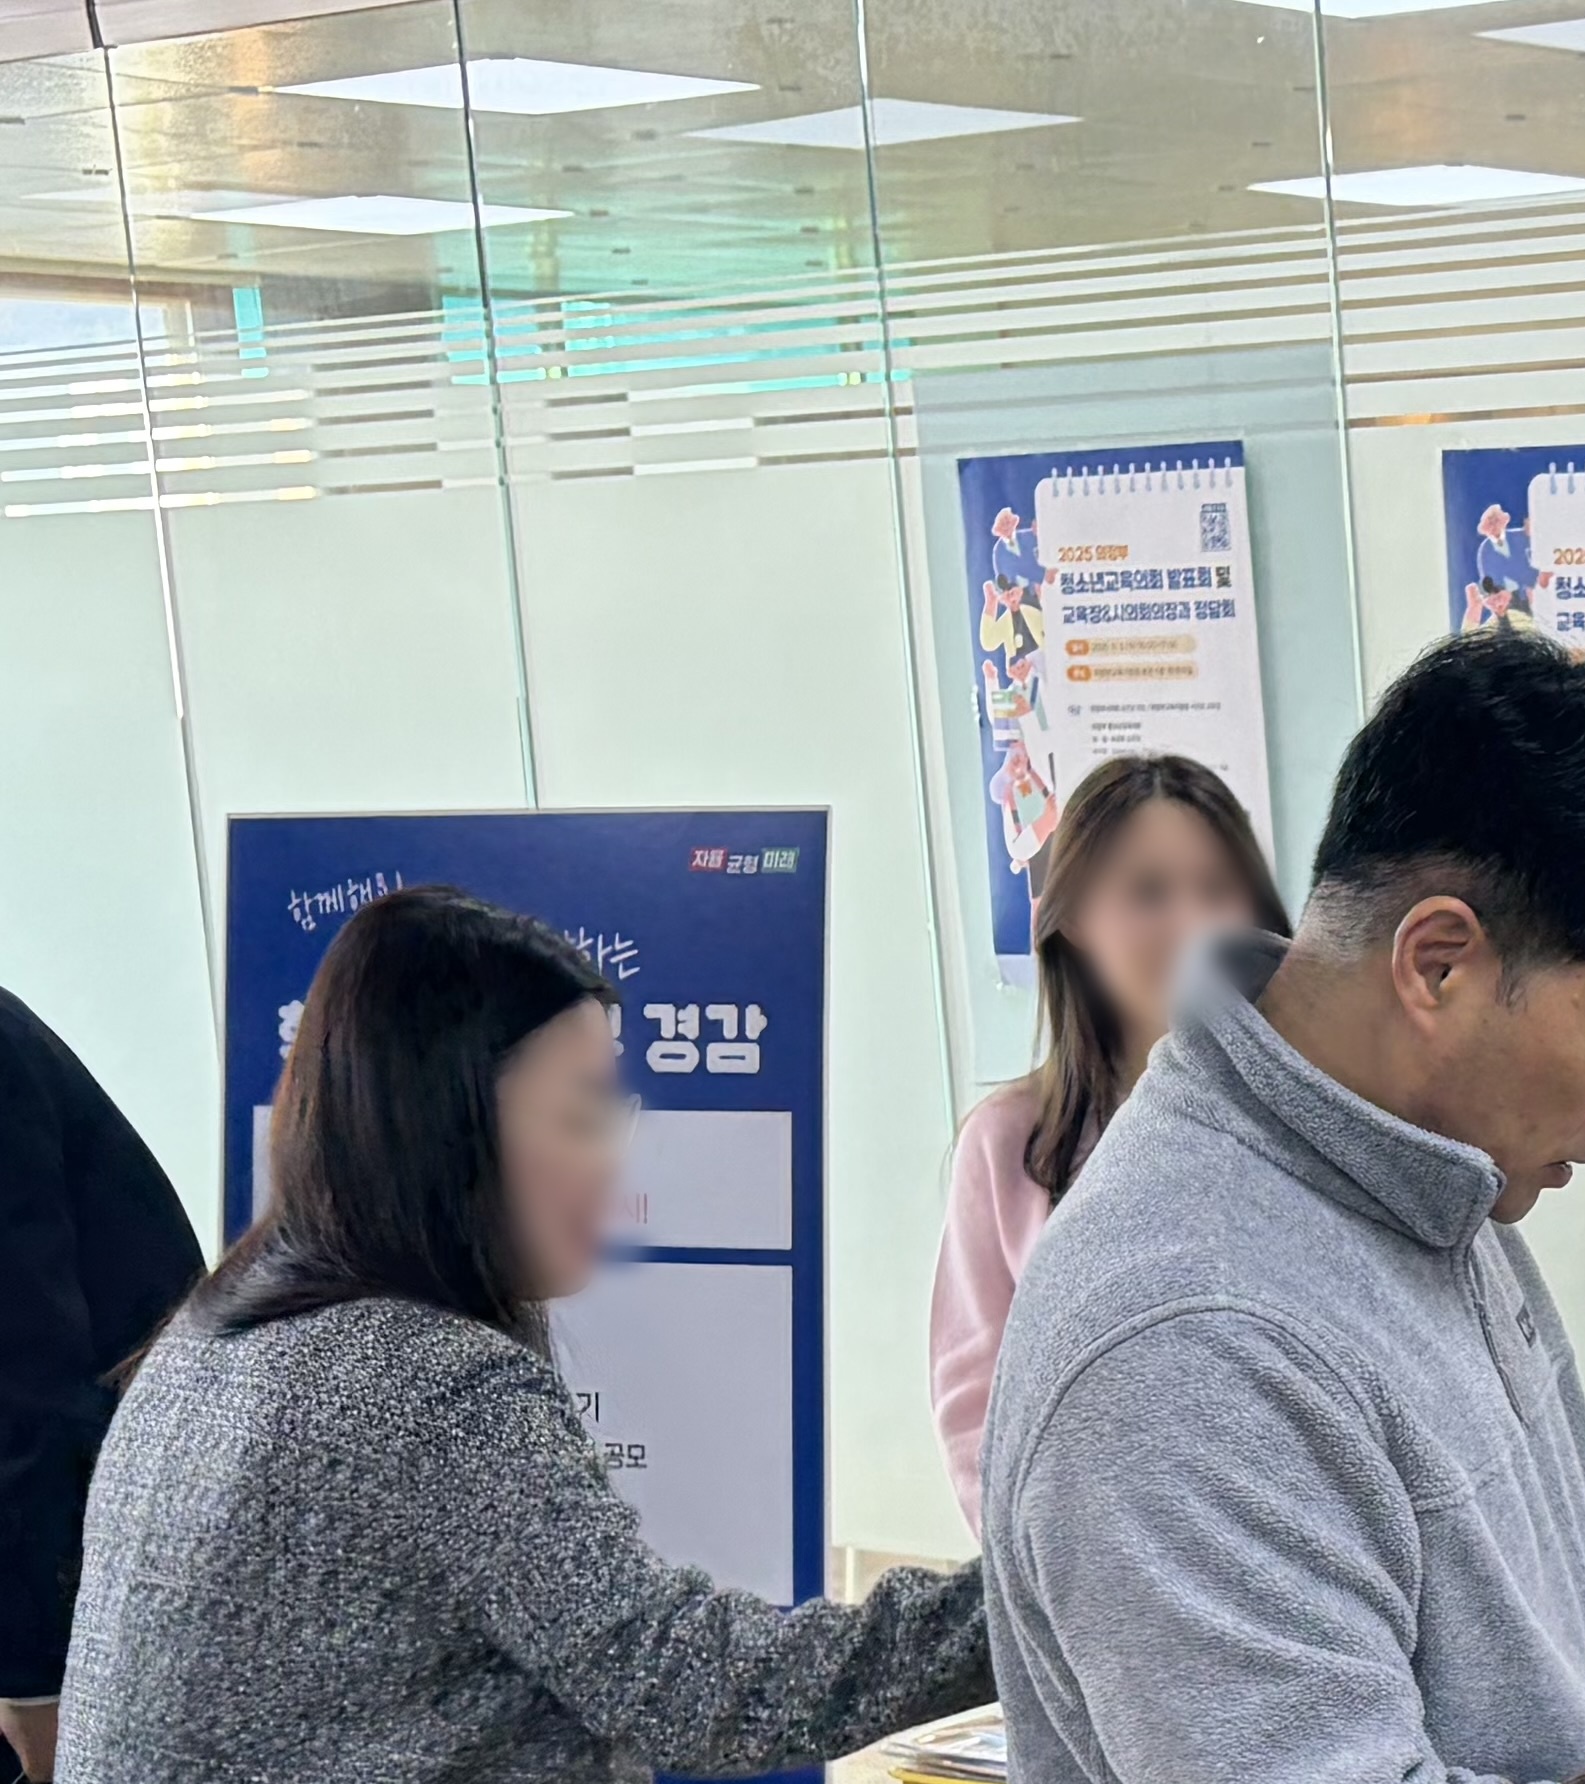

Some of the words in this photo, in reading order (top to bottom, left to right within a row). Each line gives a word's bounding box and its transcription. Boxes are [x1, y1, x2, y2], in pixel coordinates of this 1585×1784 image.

[1058, 545, 1093, 562] 2025
[692, 849, 725, 868] 자율
[727, 854, 760, 874] 균형
[763, 850, 797, 869] 미래
[564, 926, 642, 980] 하는
[643, 1002, 768, 1075] 경감
